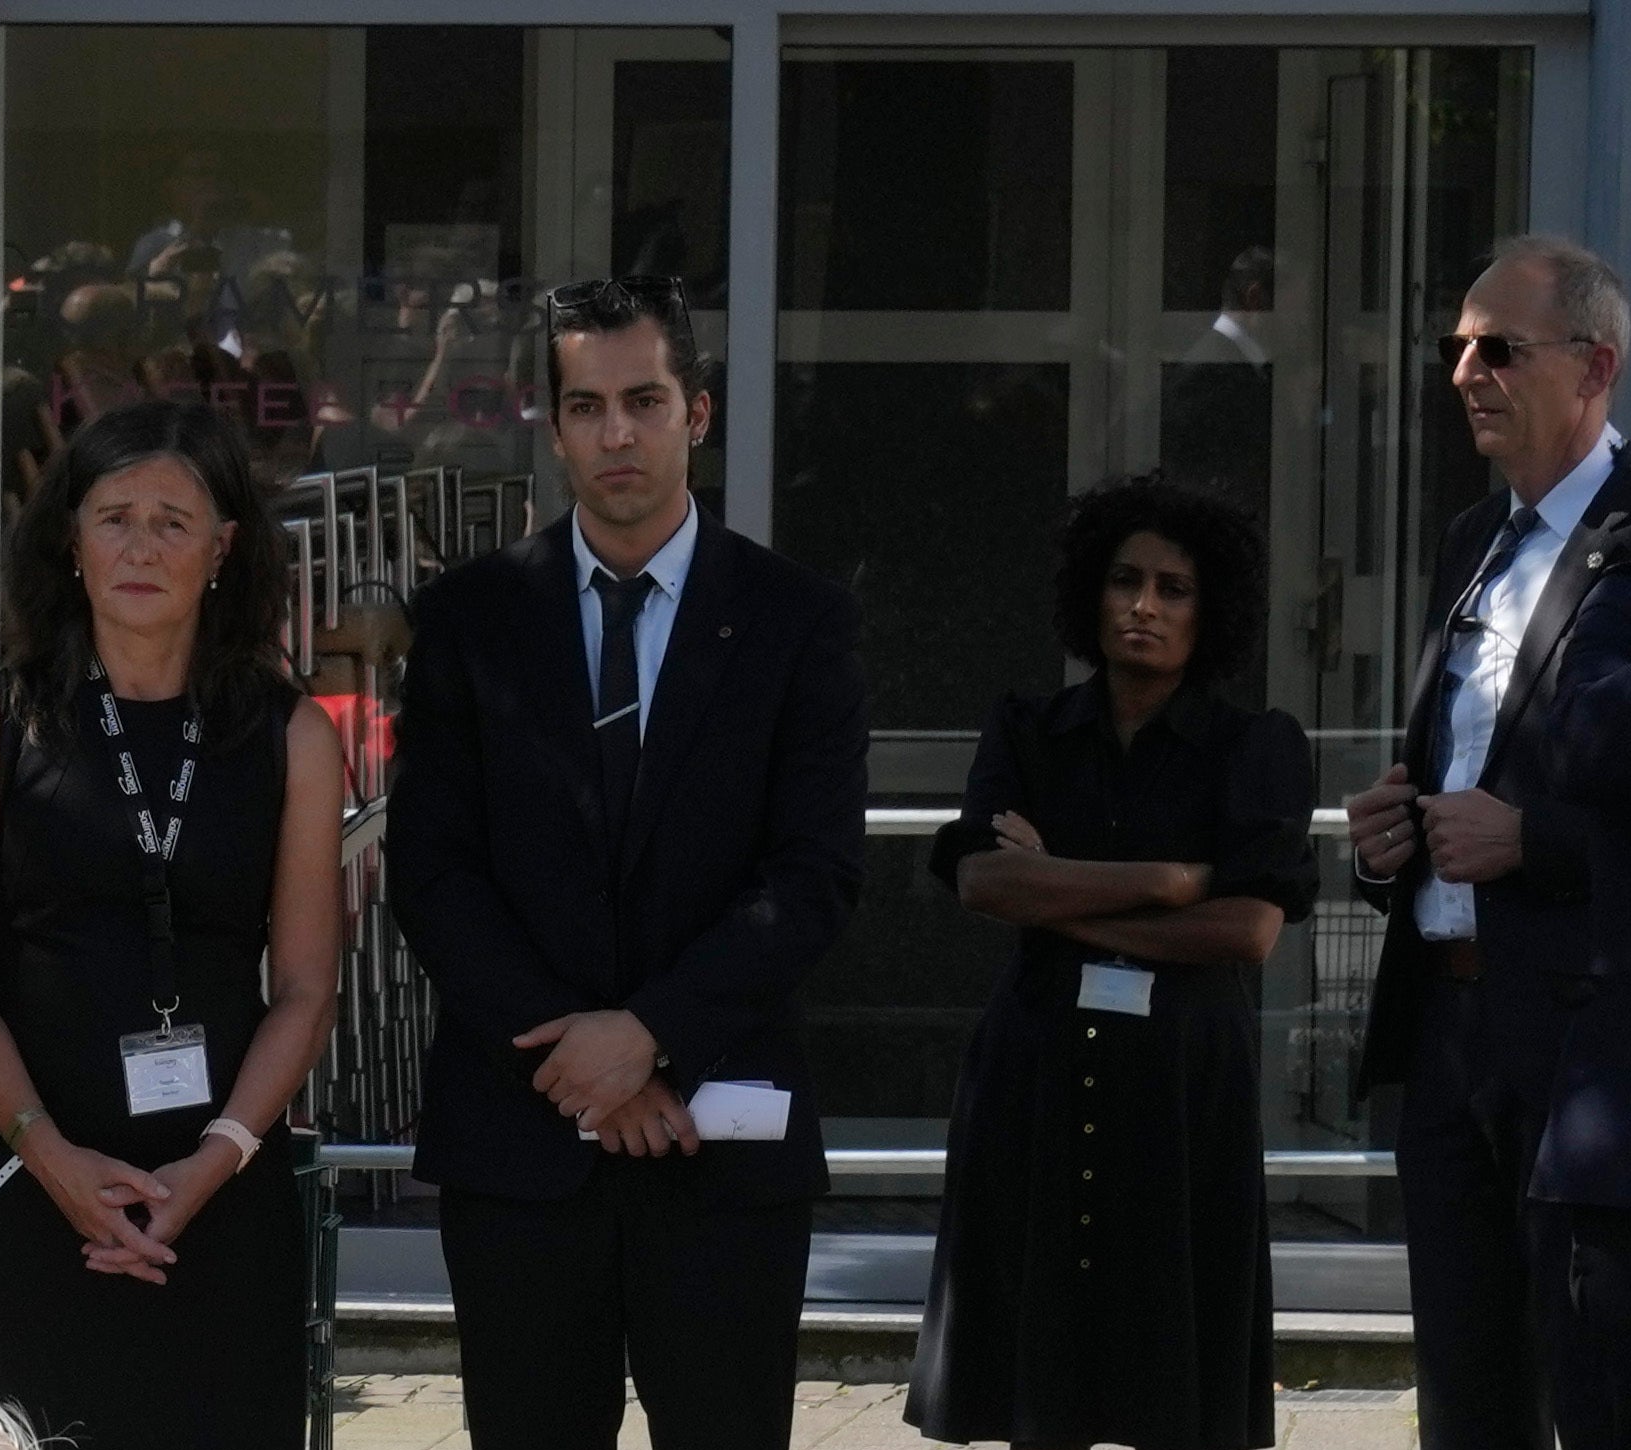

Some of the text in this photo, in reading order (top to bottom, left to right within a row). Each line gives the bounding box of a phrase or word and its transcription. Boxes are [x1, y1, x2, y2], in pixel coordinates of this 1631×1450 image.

[100, 693, 120, 737] Solingen
[118, 752, 139, 796] Solingen
[170, 758, 194, 802] Solingen
[137, 810, 157, 854] Solingen
